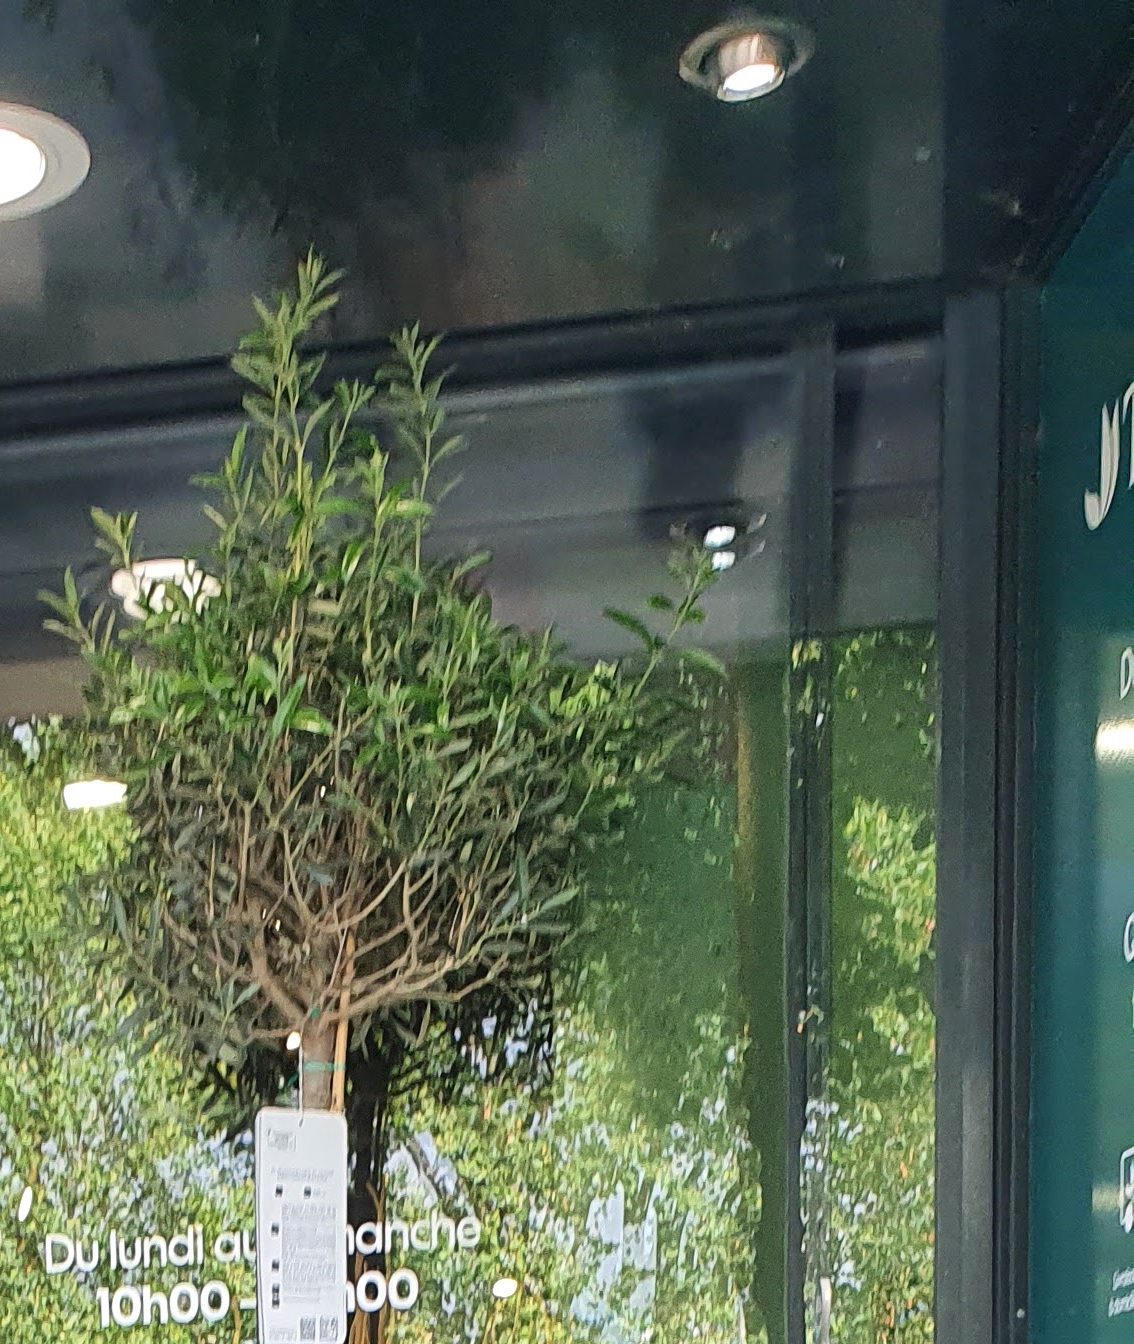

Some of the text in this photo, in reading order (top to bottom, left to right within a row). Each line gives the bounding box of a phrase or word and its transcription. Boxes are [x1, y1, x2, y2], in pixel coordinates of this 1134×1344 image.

[44, 1232, 99, 1275] Du
[109, 1224, 204, 1271] lundi
[95, 1278, 231, 1329] 10h00
